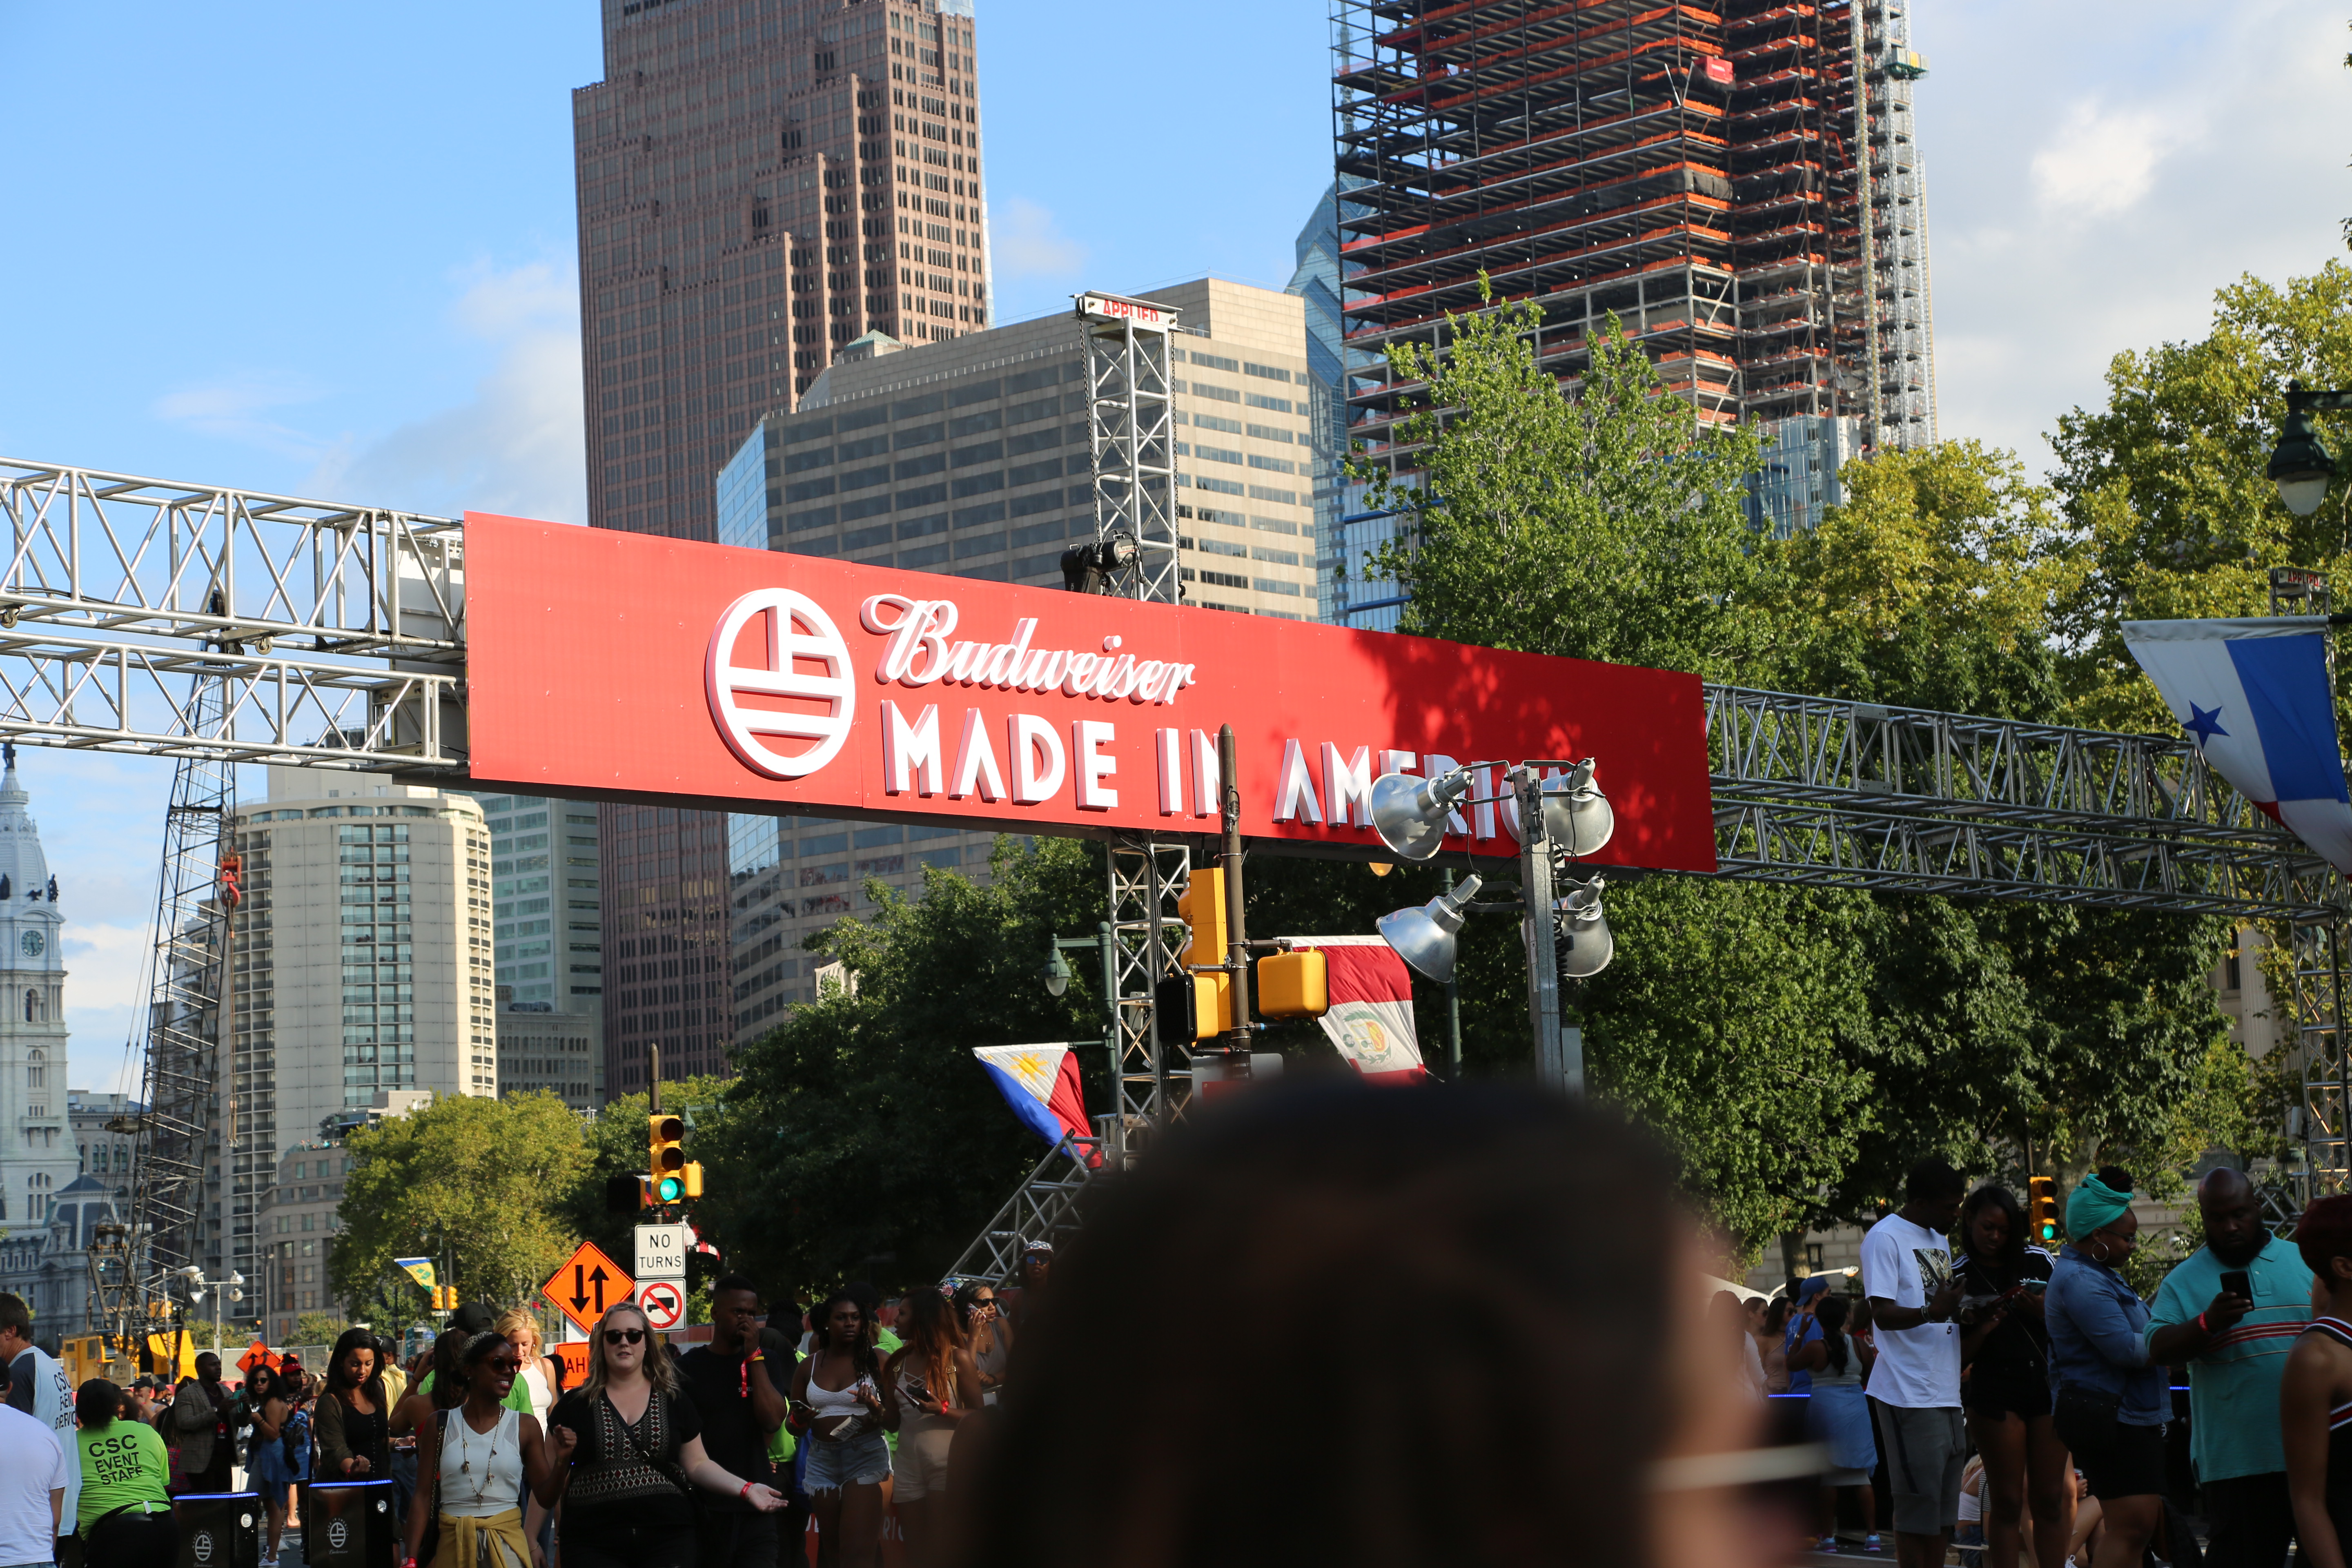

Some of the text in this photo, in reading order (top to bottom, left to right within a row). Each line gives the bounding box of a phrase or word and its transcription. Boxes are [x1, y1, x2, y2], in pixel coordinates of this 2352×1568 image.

[860, 593, 1196, 705] Budweiser
[881, 699, 1119, 810] MADE
[650, 1234, 670, 1248] NO
[639, 1255, 682, 1268] TURNS
[89, 1434, 138, 1457] CSC
[95, 1452, 139, 1474] EVENT
[100, 1466, 143, 1485] STAFF
